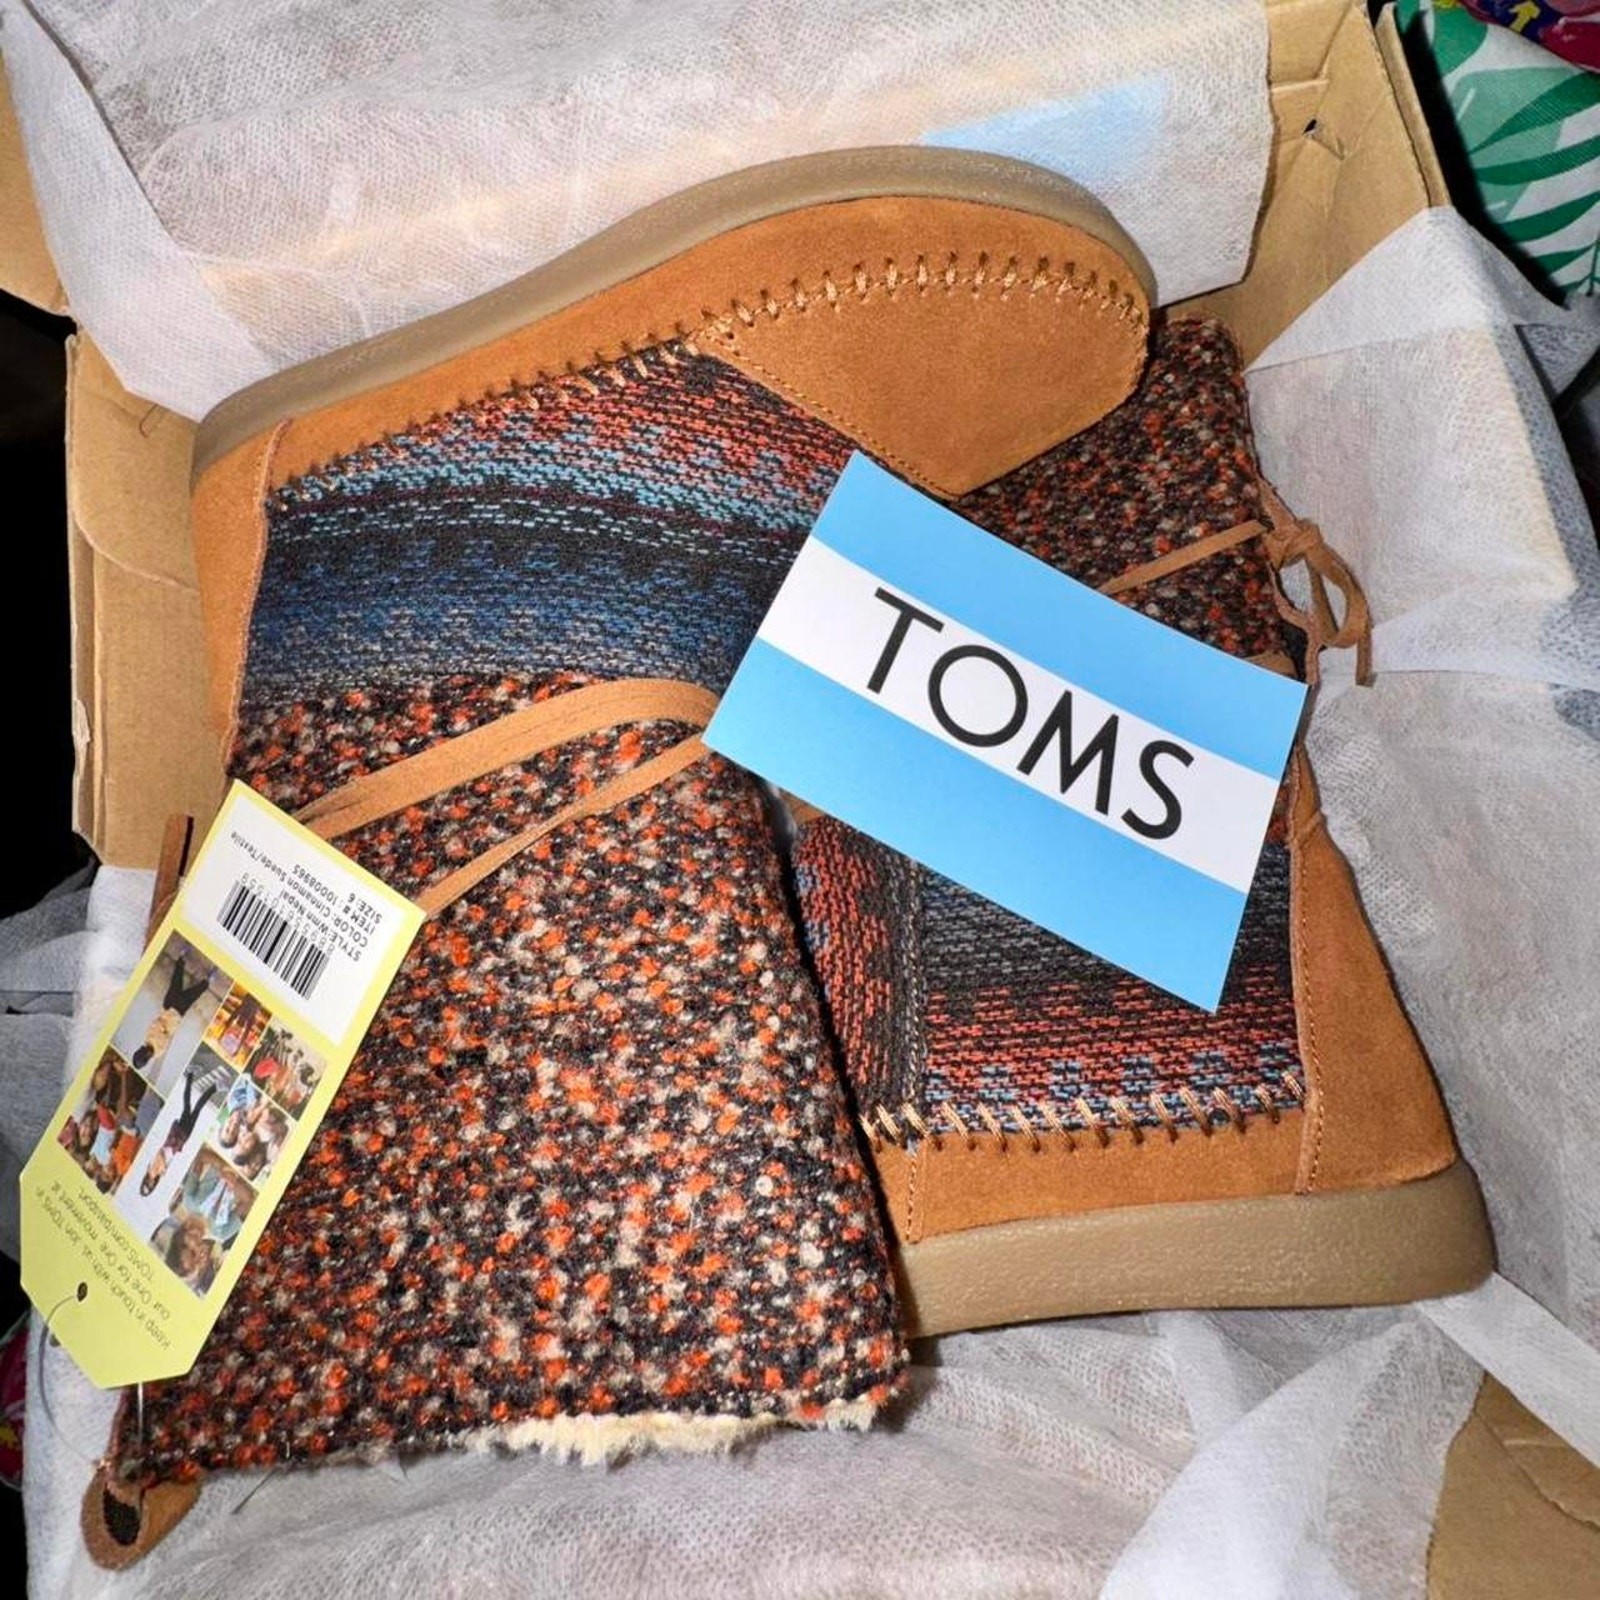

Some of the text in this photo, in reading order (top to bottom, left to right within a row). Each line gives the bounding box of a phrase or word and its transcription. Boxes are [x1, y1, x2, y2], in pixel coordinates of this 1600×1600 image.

[867, 587, 1195, 840] TOMS
[231, 831, 287, 882] Suede/Textile
[280, 888, 306, 915] Nepal
[287, 878, 331, 918] Cinnamon
[351, 911, 376, 935] ITEM
